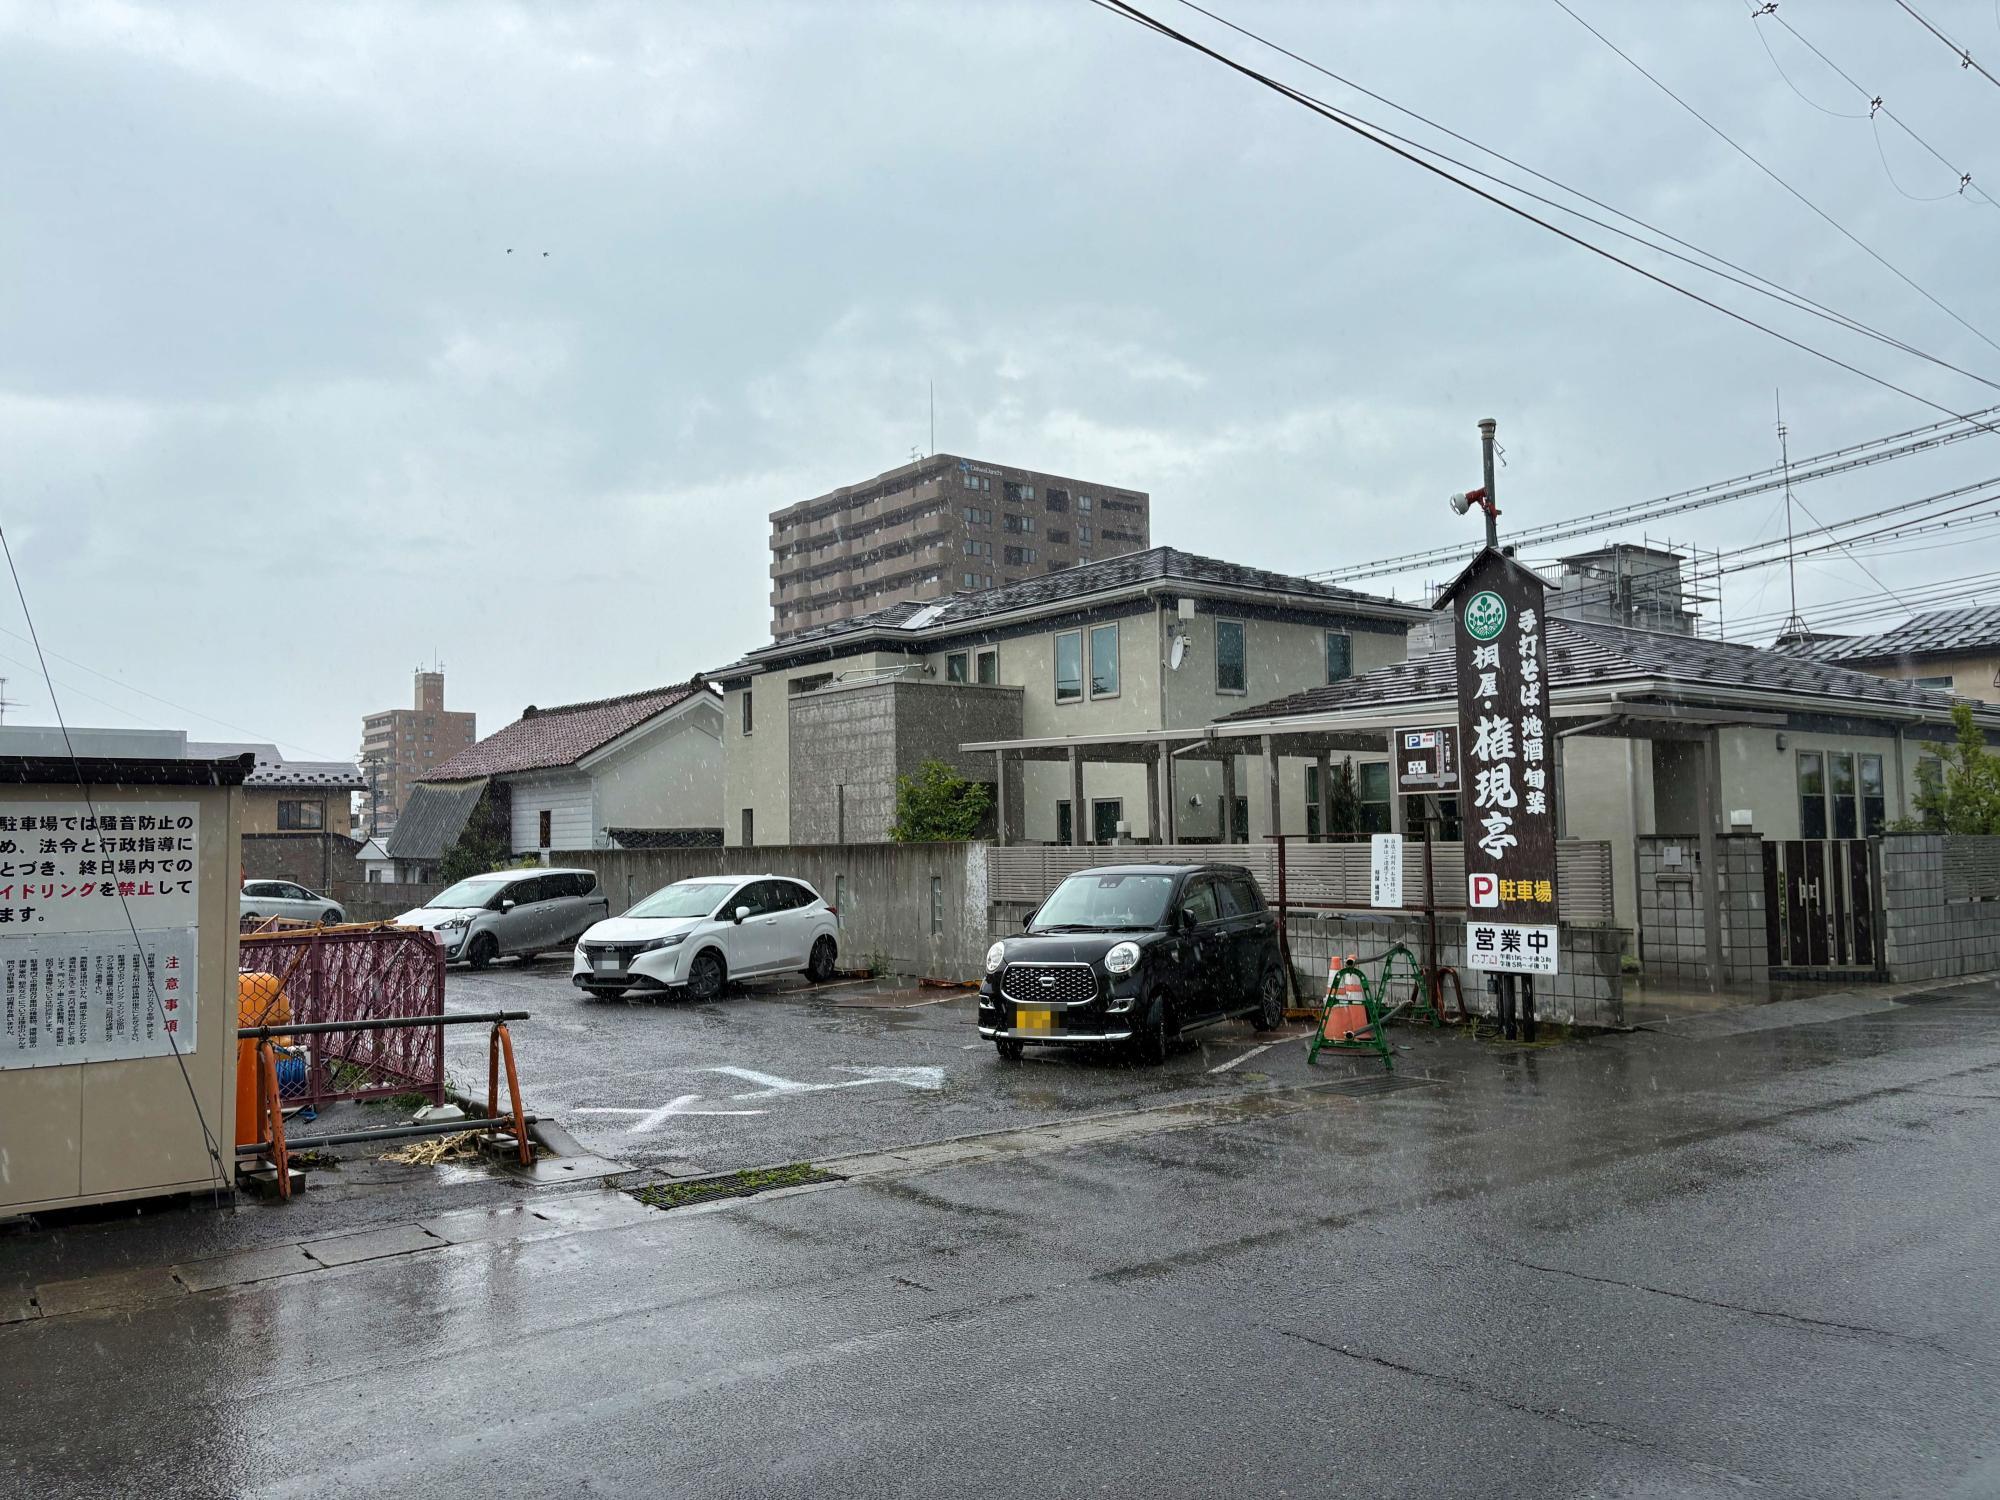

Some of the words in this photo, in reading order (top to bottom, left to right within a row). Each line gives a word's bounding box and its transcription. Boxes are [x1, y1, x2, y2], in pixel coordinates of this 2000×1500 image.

[1408, 736, 1419, 747] P
[0, 816, 194, 832] 駐車場では騒音防止の
[0, 837, 193, 854] め、法令と行政指導に
[0, 880, 193, 900] イドリングを禁止して
[1474, 877, 1494, 904] P
[1499, 879, 1552, 903] 駐車場
[0, 906, 46, 923] ます。
[1475, 927, 1549, 955] 営業中
[164, 956, 179, 1033] 注意事項
